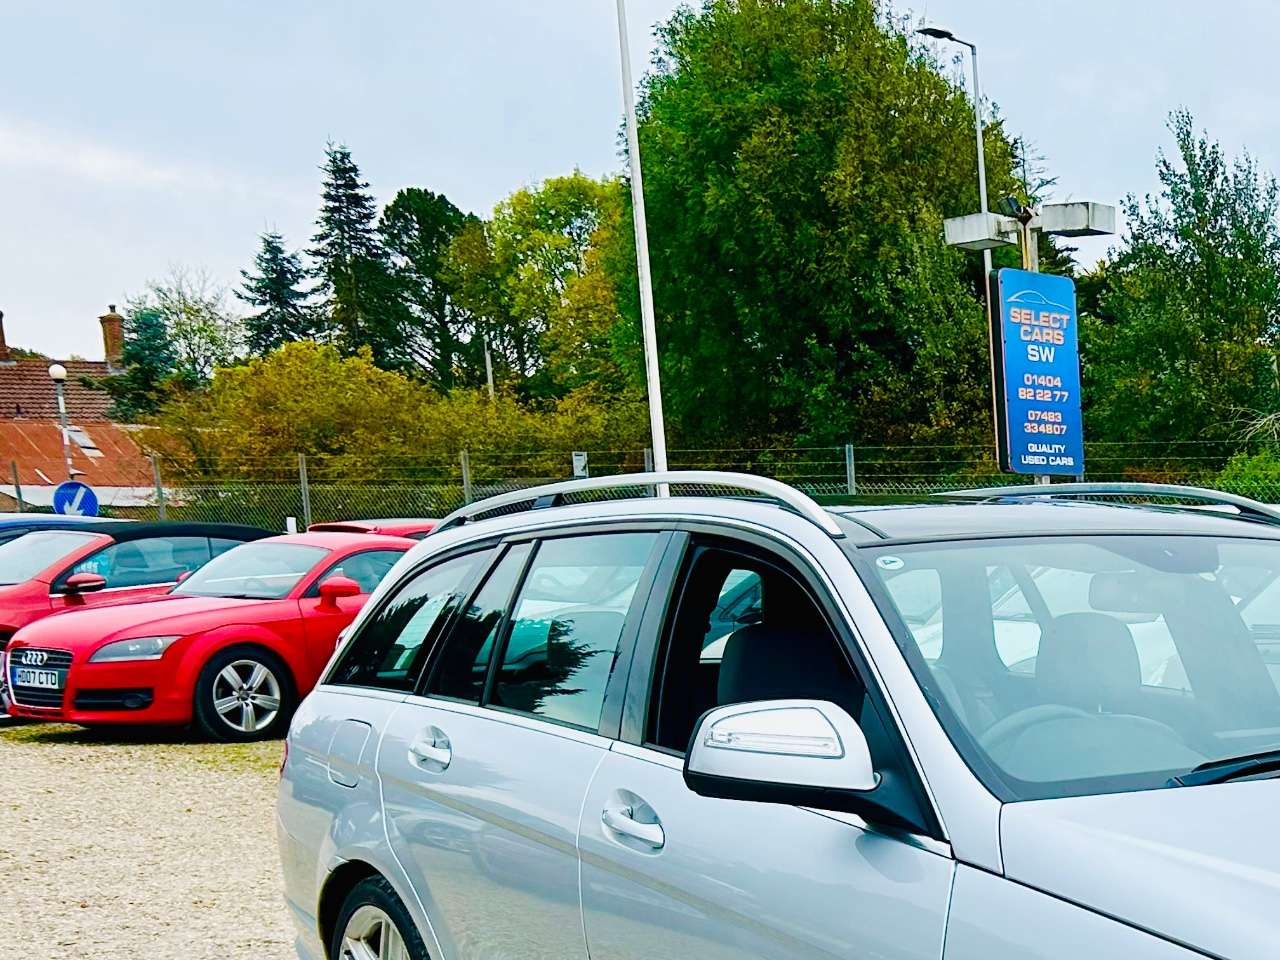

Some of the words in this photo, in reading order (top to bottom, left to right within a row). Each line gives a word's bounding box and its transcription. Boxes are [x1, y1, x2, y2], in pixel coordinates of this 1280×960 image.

[1010, 307, 1070, 328] SELECT
[1020, 325, 1064, 345] CARS
[1027, 344, 1055, 363] SW
[1023, 373, 1062, 388] 01404
[1027, 443, 1066, 454] QUALITY
[1021, 455, 1047, 465] USED
[1048, 456, 1074, 466] CARS
